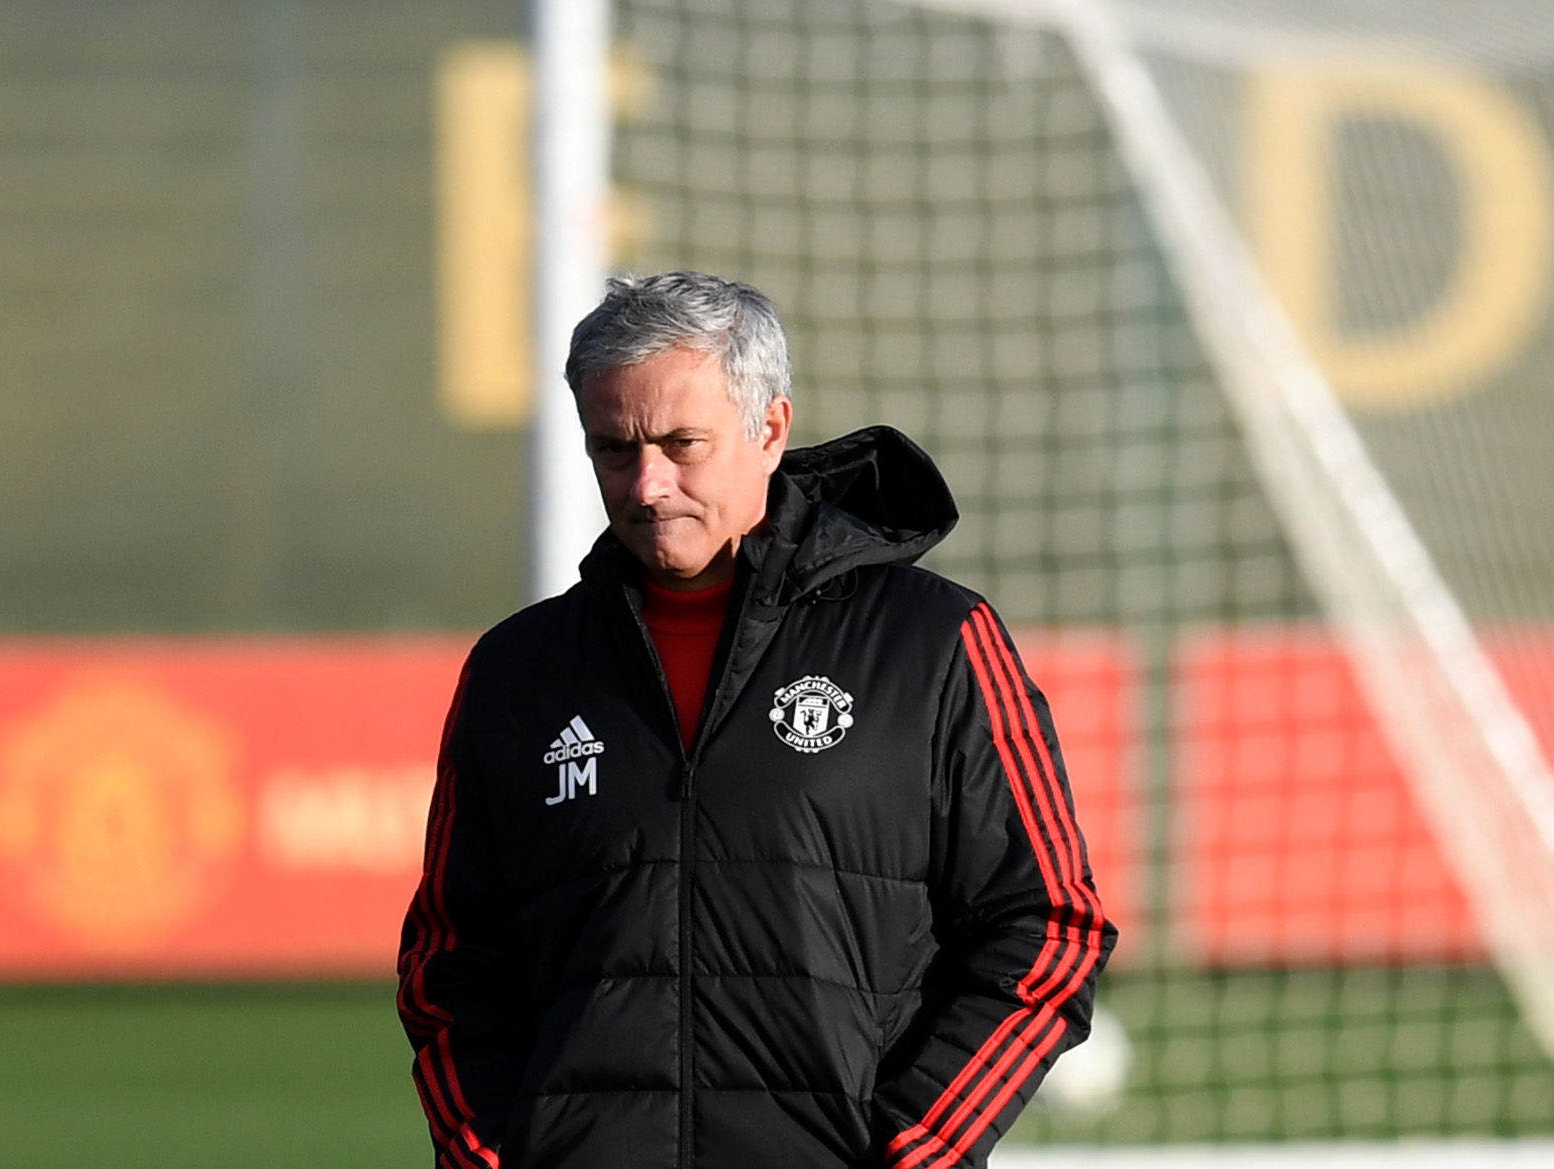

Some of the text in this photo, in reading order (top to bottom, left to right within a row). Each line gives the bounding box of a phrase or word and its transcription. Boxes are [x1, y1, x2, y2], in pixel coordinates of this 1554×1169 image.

[779, 681, 847, 709] MANCHESTER
[785, 732, 833, 747] UNITED
[543, 741, 605, 764] adidas
[545, 756, 597, 805] JM
